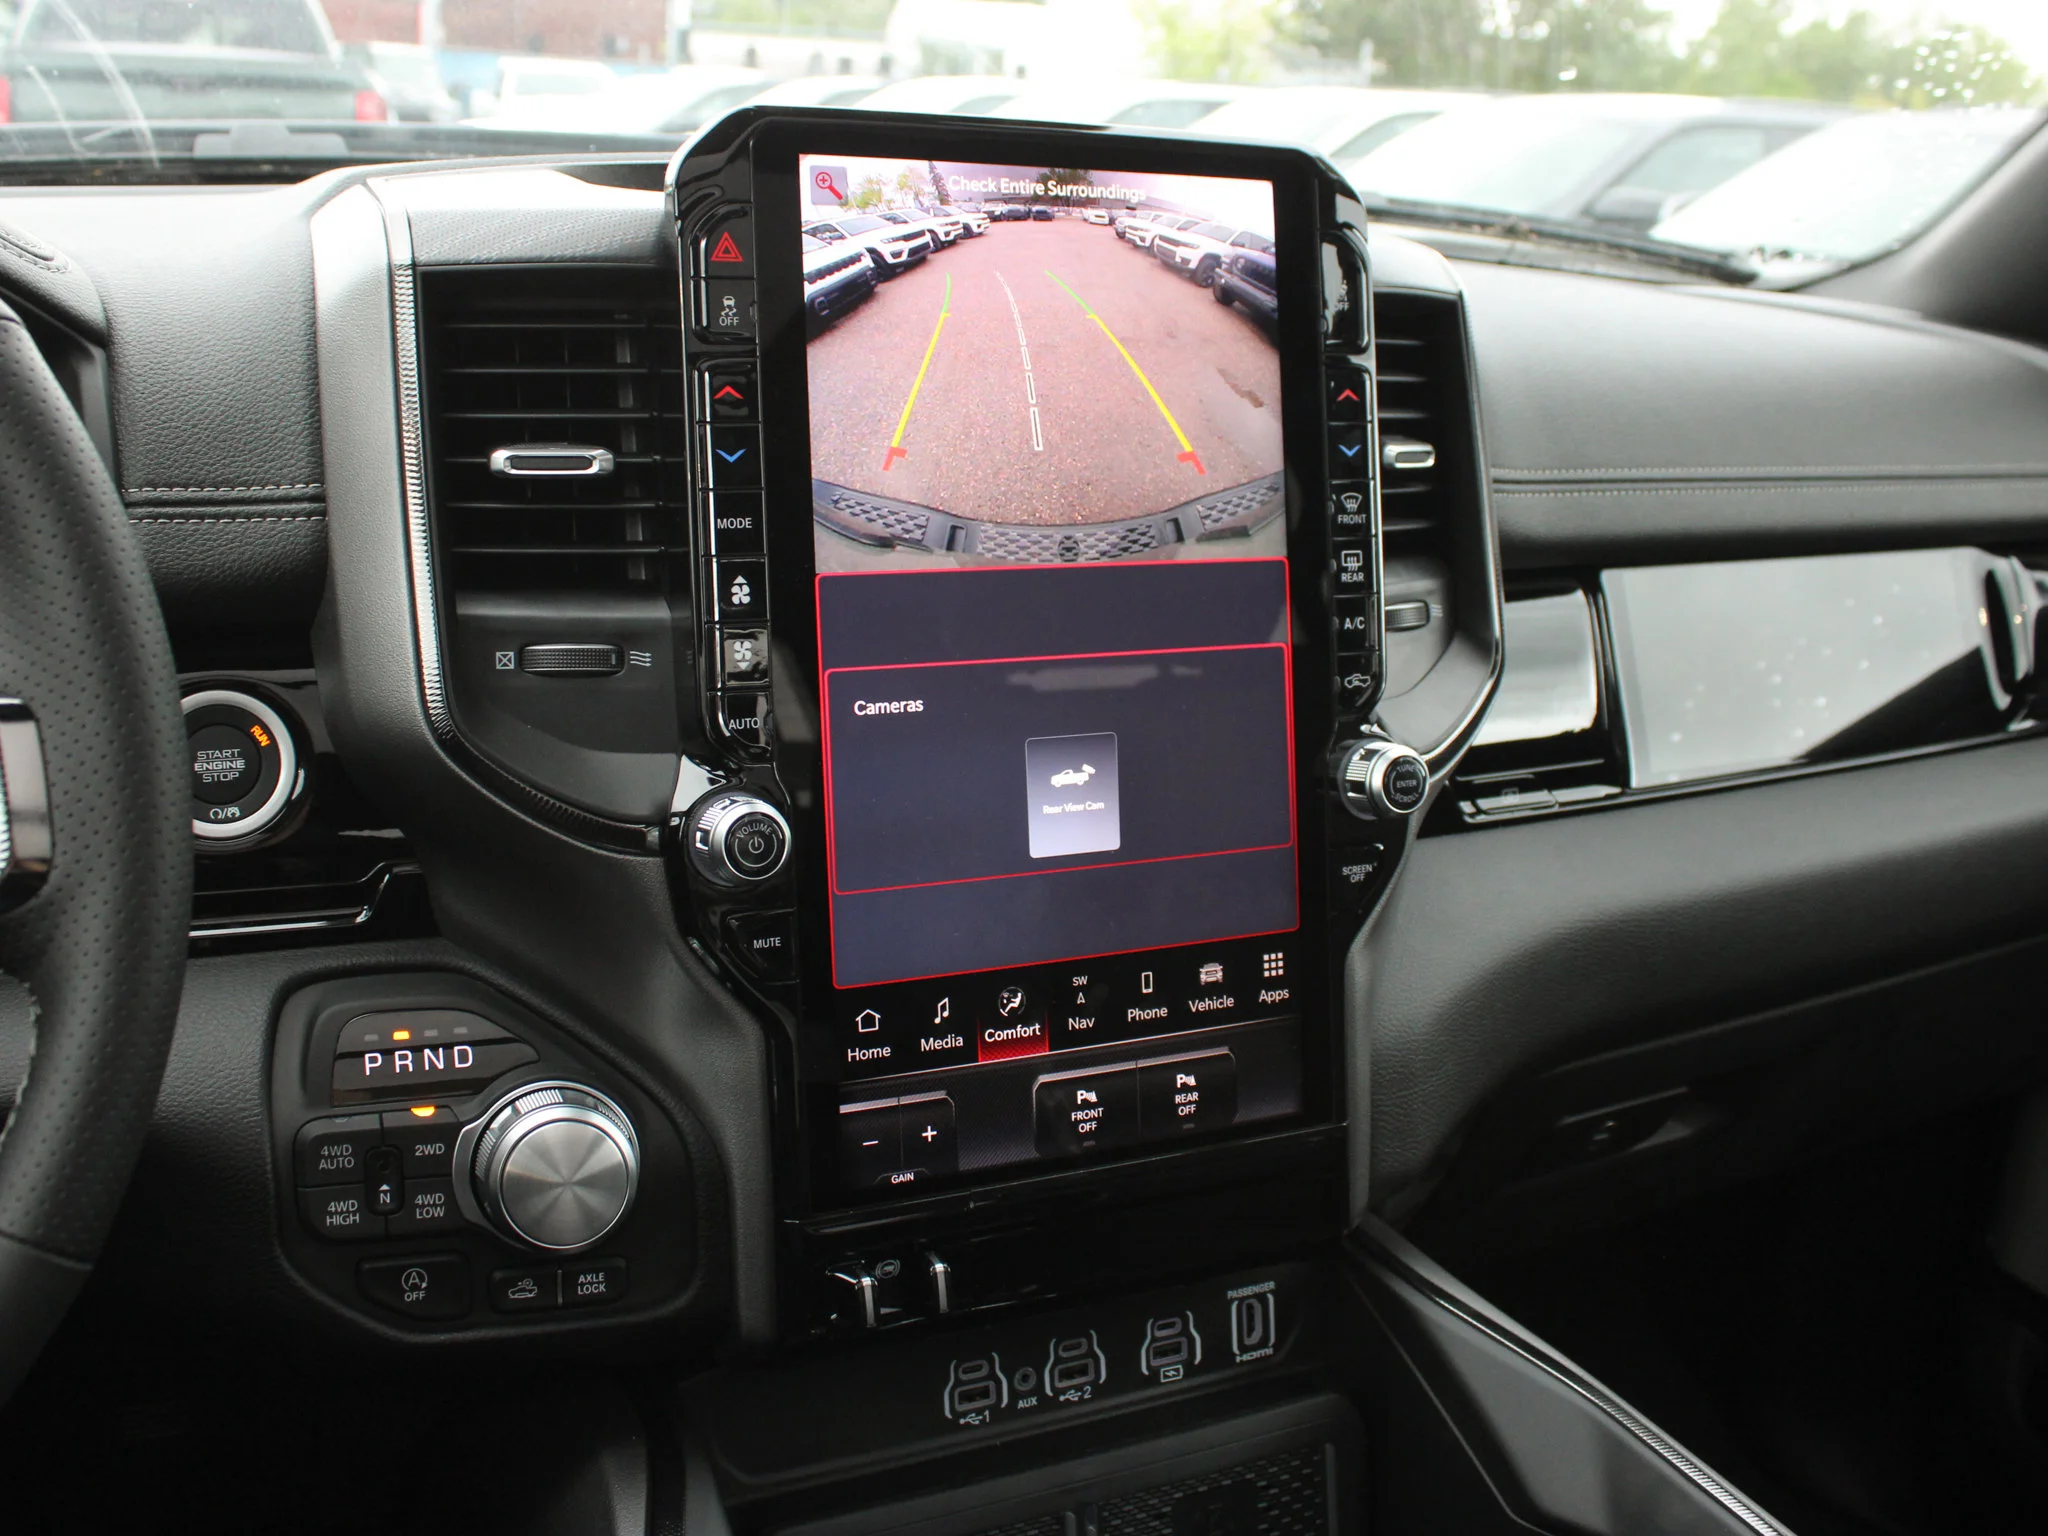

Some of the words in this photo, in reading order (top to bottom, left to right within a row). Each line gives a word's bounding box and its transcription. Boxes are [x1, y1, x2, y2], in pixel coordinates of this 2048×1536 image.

[950, 176, 997, 193] Check
[1001, 177, 1044, 196] Entire
[1047, 180, 1147, 202] Surroundings
[719, 316, 740, 326] OFF
[717, 518, 752, 529] MODE
[1337, 514, 1367, 525] FRONT
[1341, 572, 1364, 582] REAR
[1344, 617, 1365, 630] A/C
[854, 699, 924, 716] Cameras
[728, 717, 760, 729] AUTO
[250, 725, 271, 747] RUN
[197, 749, 240, 760] START
[194, 760, 245, 771] ENGINE
[203, 771, 239, 782] STOP
[1396, 779, 1417, 788] ENTER
[1042, 804, 1063, 815] Rear
[1064, 802, 1084, 813] View
[1085, 800, 1104, 811] Cam
[737, 822, 773, 839] VOLUME
[1342, 864, 1372, 875] SCREEN
[1350, 874, 1366, 883] OFF
[753, 937, 782, 949] MUTE
[1072, 976, 1088, 986] SW
[1259, 988, 1290, 1004] Apps
[1189, 995, 1234, 1013] Vehicle
[1127, 1006, 1168, 1022] Phone
[1068, 1017, 1095, 1030] Nav
[984, 1022, 1041, 1042] Comfort
[920, 1034, 964, 1051] Media
[847, 1045, 891, 1062] Home
[1175, 1092, 1199, 1104] REAR
[1071, 1108, 1104, 1122] FRONT
[1178, 1104, 1196, 1116] OFF
[1078, 1121, 1097, 1133] OFF
[320, 1144, 352, 1156] 4WD
[415, 1143, 445, 1156] 2WD
[319, 1157, 355, 1170] AUTO
[891, 1172, 914, 1184] GAIN
[415, 1193, 445, 1206] 4WD
[327, 1200, 358, 1213] 4WD
[416, 1206, 445, 1219] LOW
[326, 1212, 360, 1226] HIGH
[578, 1272, 605, 1283] AXLE
[578, 1282, 606, 1295] LOCK
[1227, 1281, 1275, 1299] PASSENGER
[404, 1291, 426, 1302] OFF
[1236, 1348, 1274, 1363] HDMI
[1083, 1385, 1092, 1399] 2
[1017, 1396, 1038, 1409] AUX
